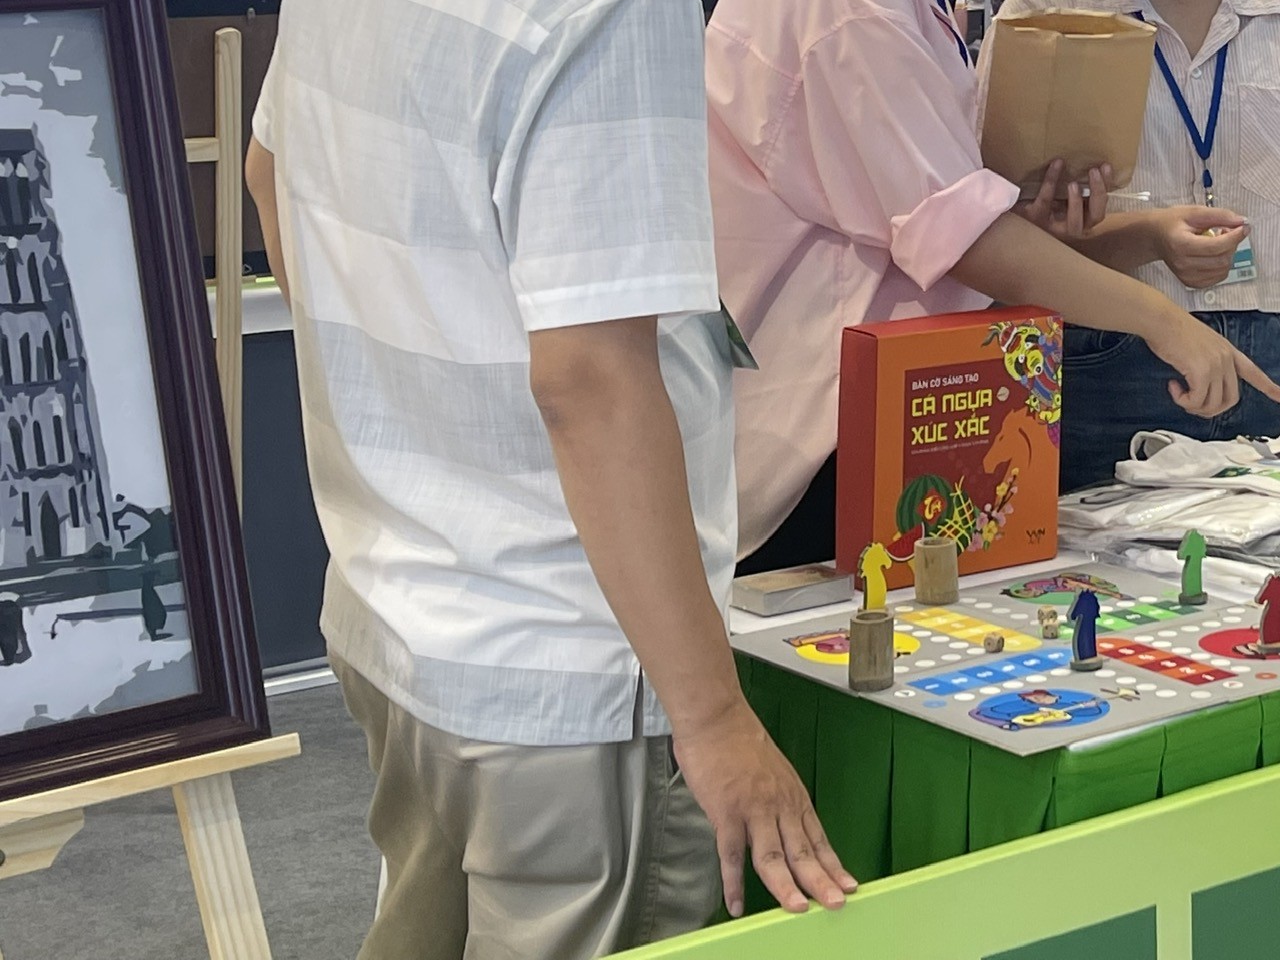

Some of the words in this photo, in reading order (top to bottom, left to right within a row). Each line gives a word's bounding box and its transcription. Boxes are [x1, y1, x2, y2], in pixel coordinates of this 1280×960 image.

[911, 393, 936, 417] CÁ
[942, 388, 993, 412] NGỰA
[911, 421, 948, 445] XÚC
[954, 412, 990, 439] XẮC
